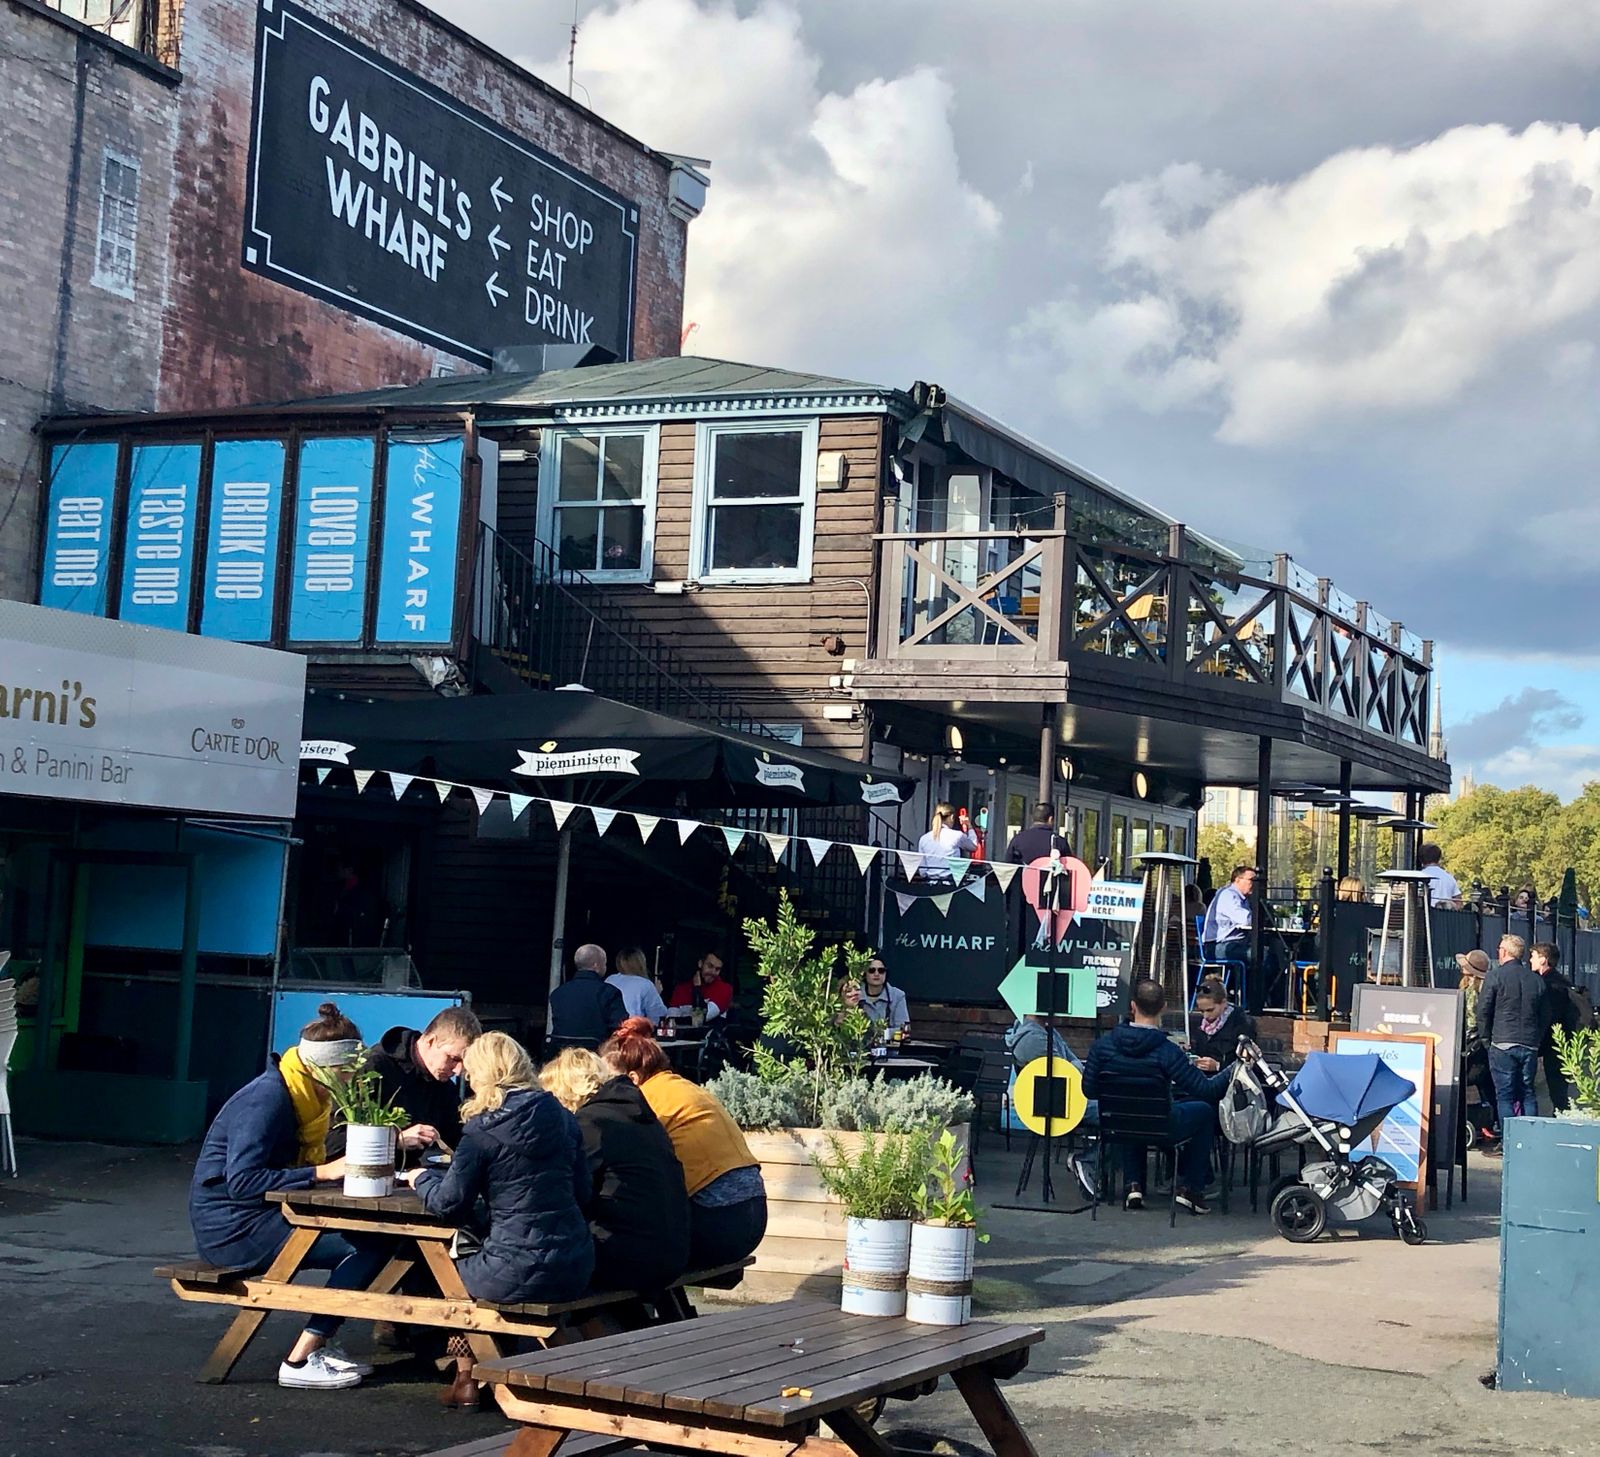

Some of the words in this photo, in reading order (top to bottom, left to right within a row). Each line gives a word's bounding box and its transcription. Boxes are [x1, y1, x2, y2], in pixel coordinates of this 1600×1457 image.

[309, 75, 471, 240] GABRIEL'S
[326, 156, 448, 282] WHARF
[530, 193, 595, 256] SHOP
[527, 239, 567, 289] EAT
[525, 288, 595, 344] DRINK
[413, 446, 436, 489] the
[403, 491, 435, 632] WHARF
[11, 746, 28, 775] &
[35, 747, 95, 781] Panini
[100, 755, 134, 785] Bar
[191, 727, 241, 753] CARTE
[244, 736, 285, 764] D'OR
[536, 752, 621, 772] pieminister
[1092, 906, 1116, 916] HERE!
[1094, 894, 1137, 909] CREAM
[895, 932, 919, 948] the
[920, 933, 996, 951] WHARF
